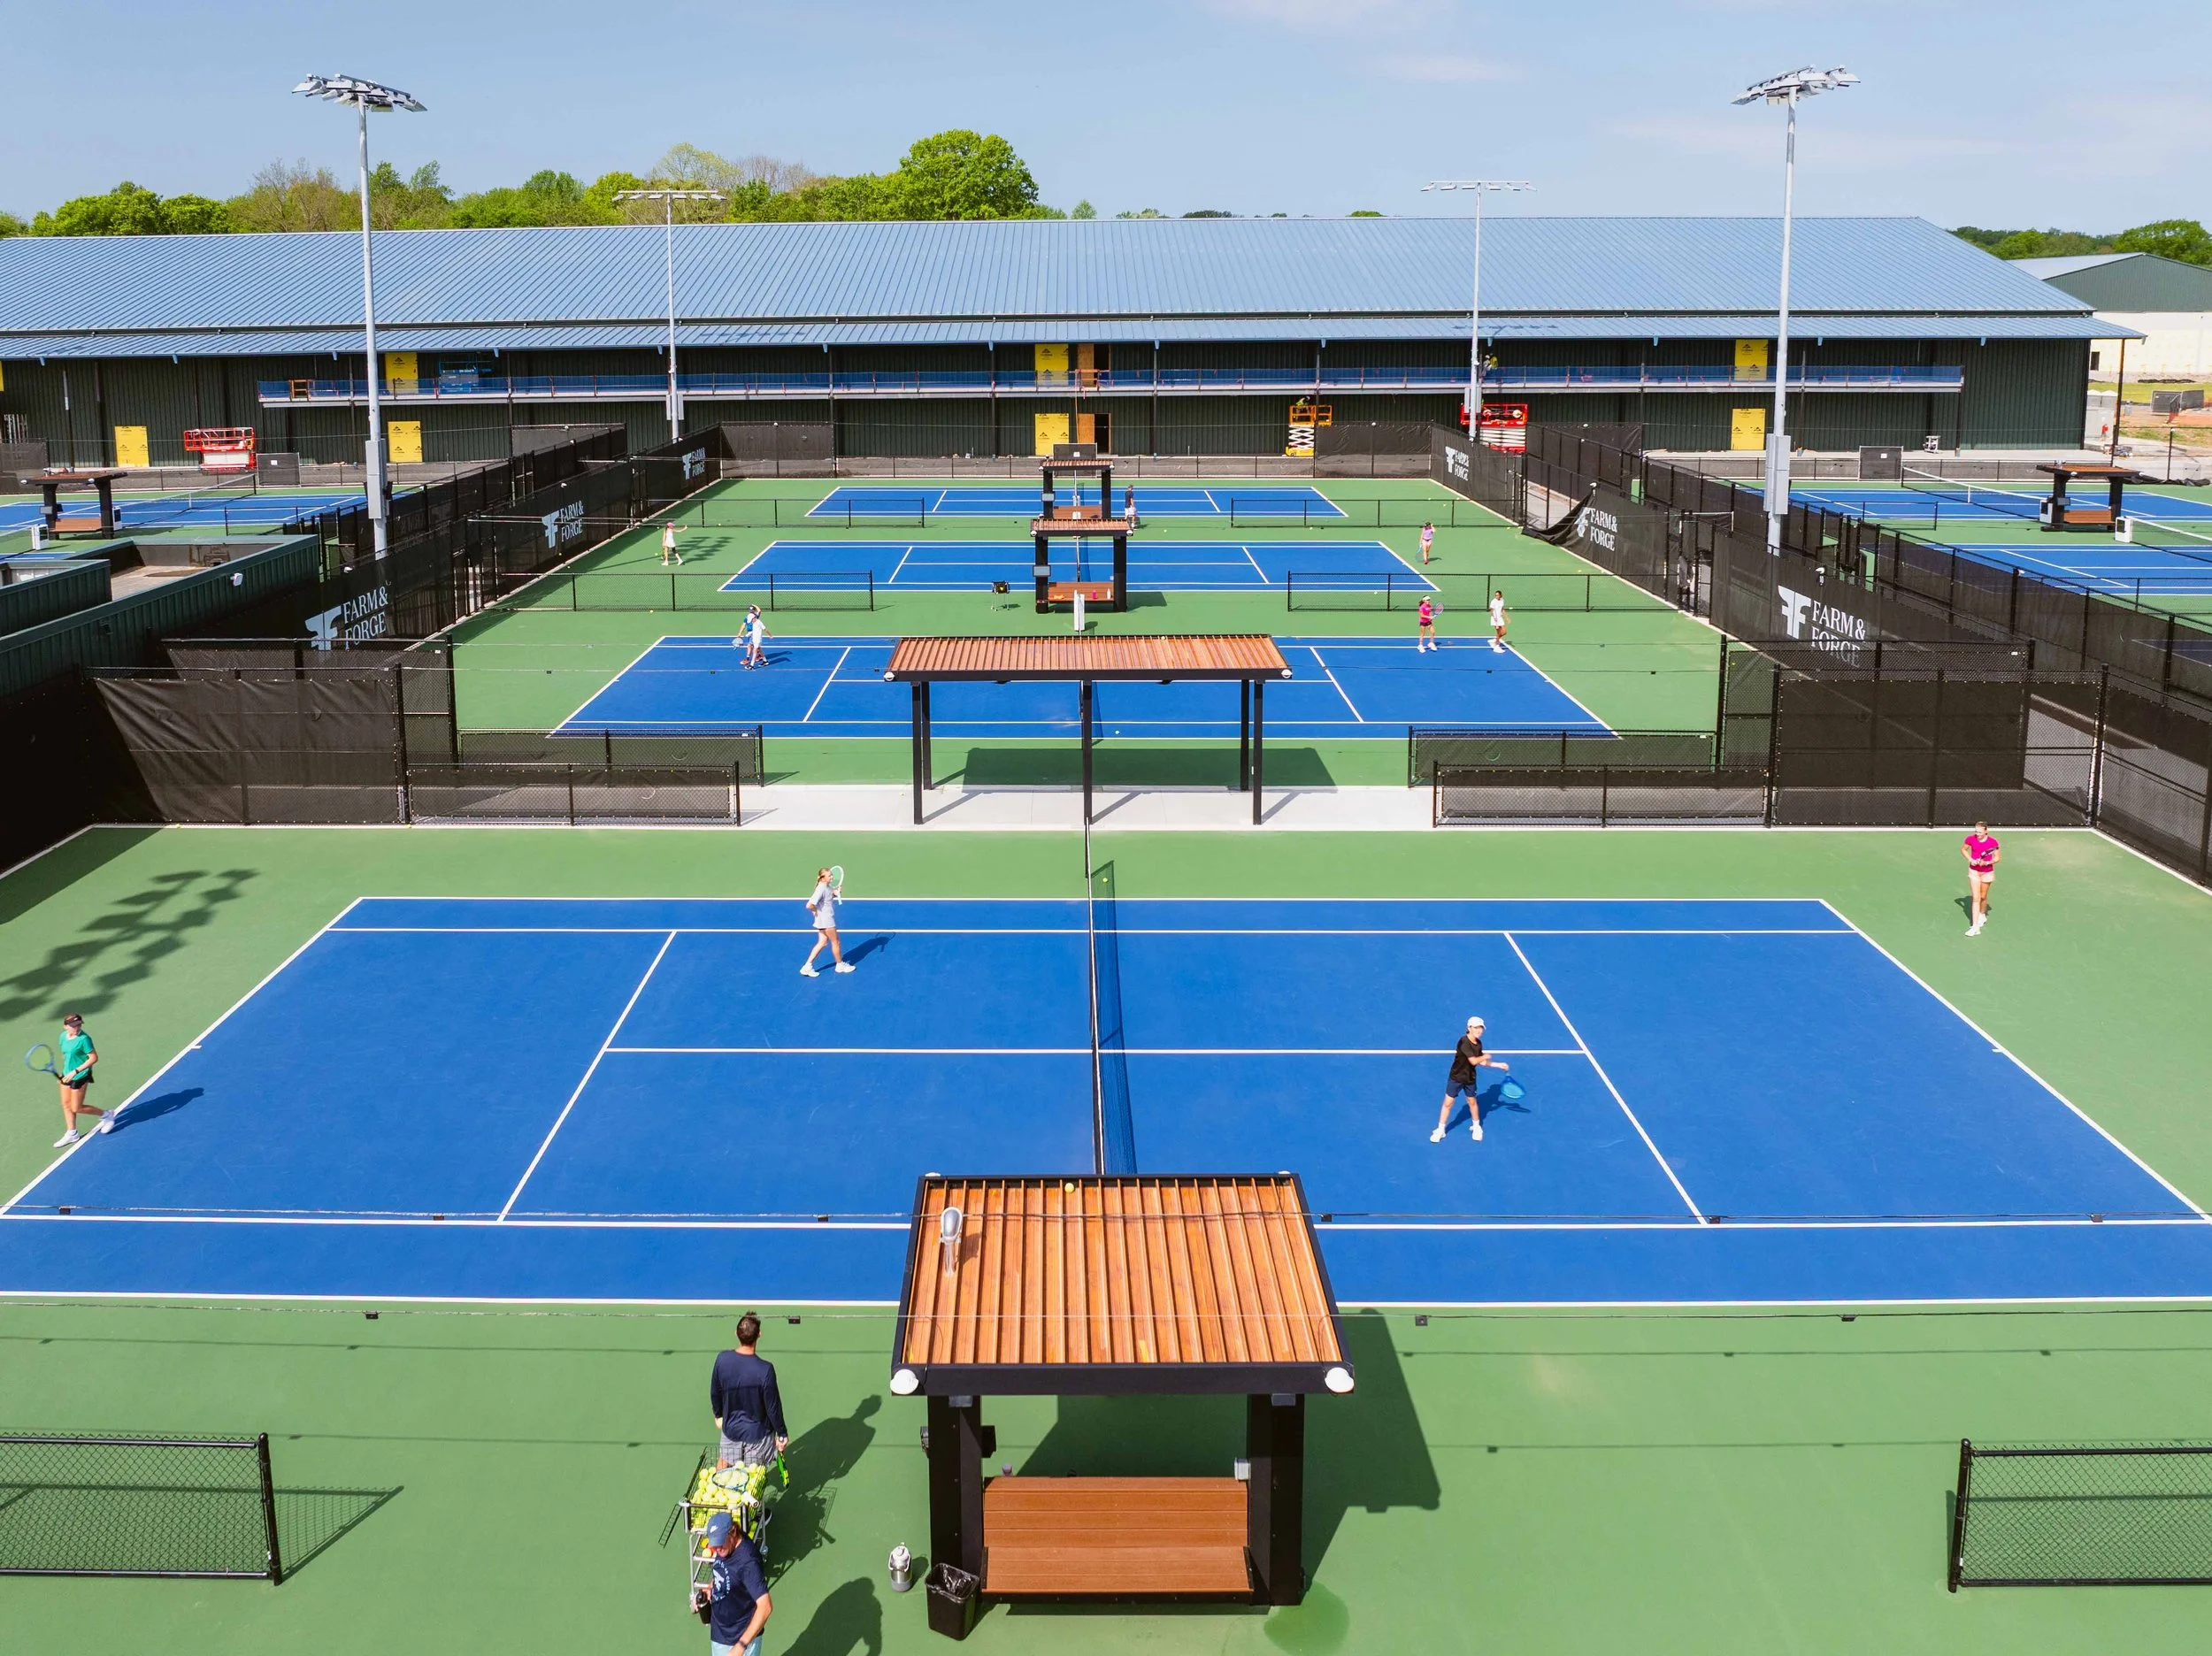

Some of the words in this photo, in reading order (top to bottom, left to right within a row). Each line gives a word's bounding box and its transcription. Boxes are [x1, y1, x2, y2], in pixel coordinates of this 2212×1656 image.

[561, 518, 583, 542] FORGE
[1590, 525, 1616, 551] FORGE
[345, 611, 387, 651] FORGE
